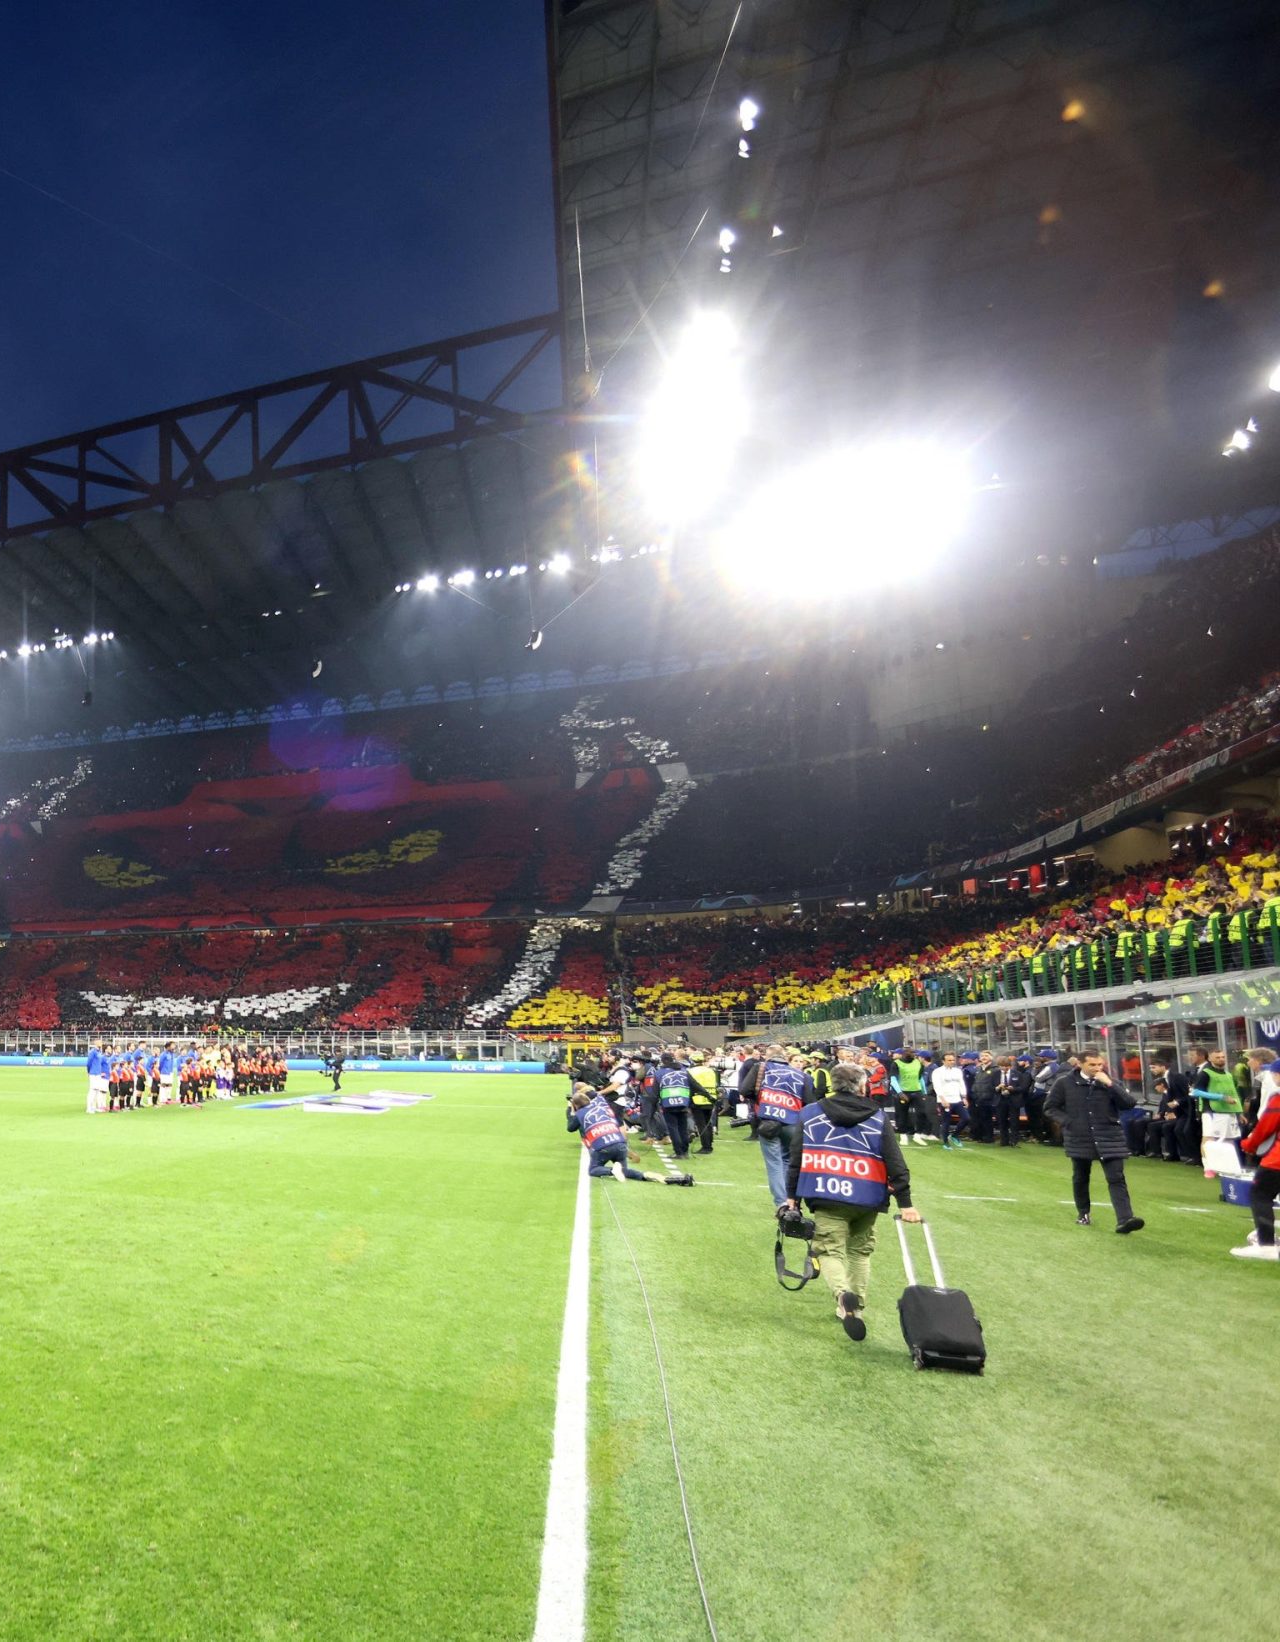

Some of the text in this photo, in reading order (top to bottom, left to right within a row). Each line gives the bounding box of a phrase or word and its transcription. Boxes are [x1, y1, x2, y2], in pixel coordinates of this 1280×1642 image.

[764, 1105, 786, 1119] 120
[802, 1153, 870, 1176] PHOTO
[815, 1176, 853, 1196] 108
